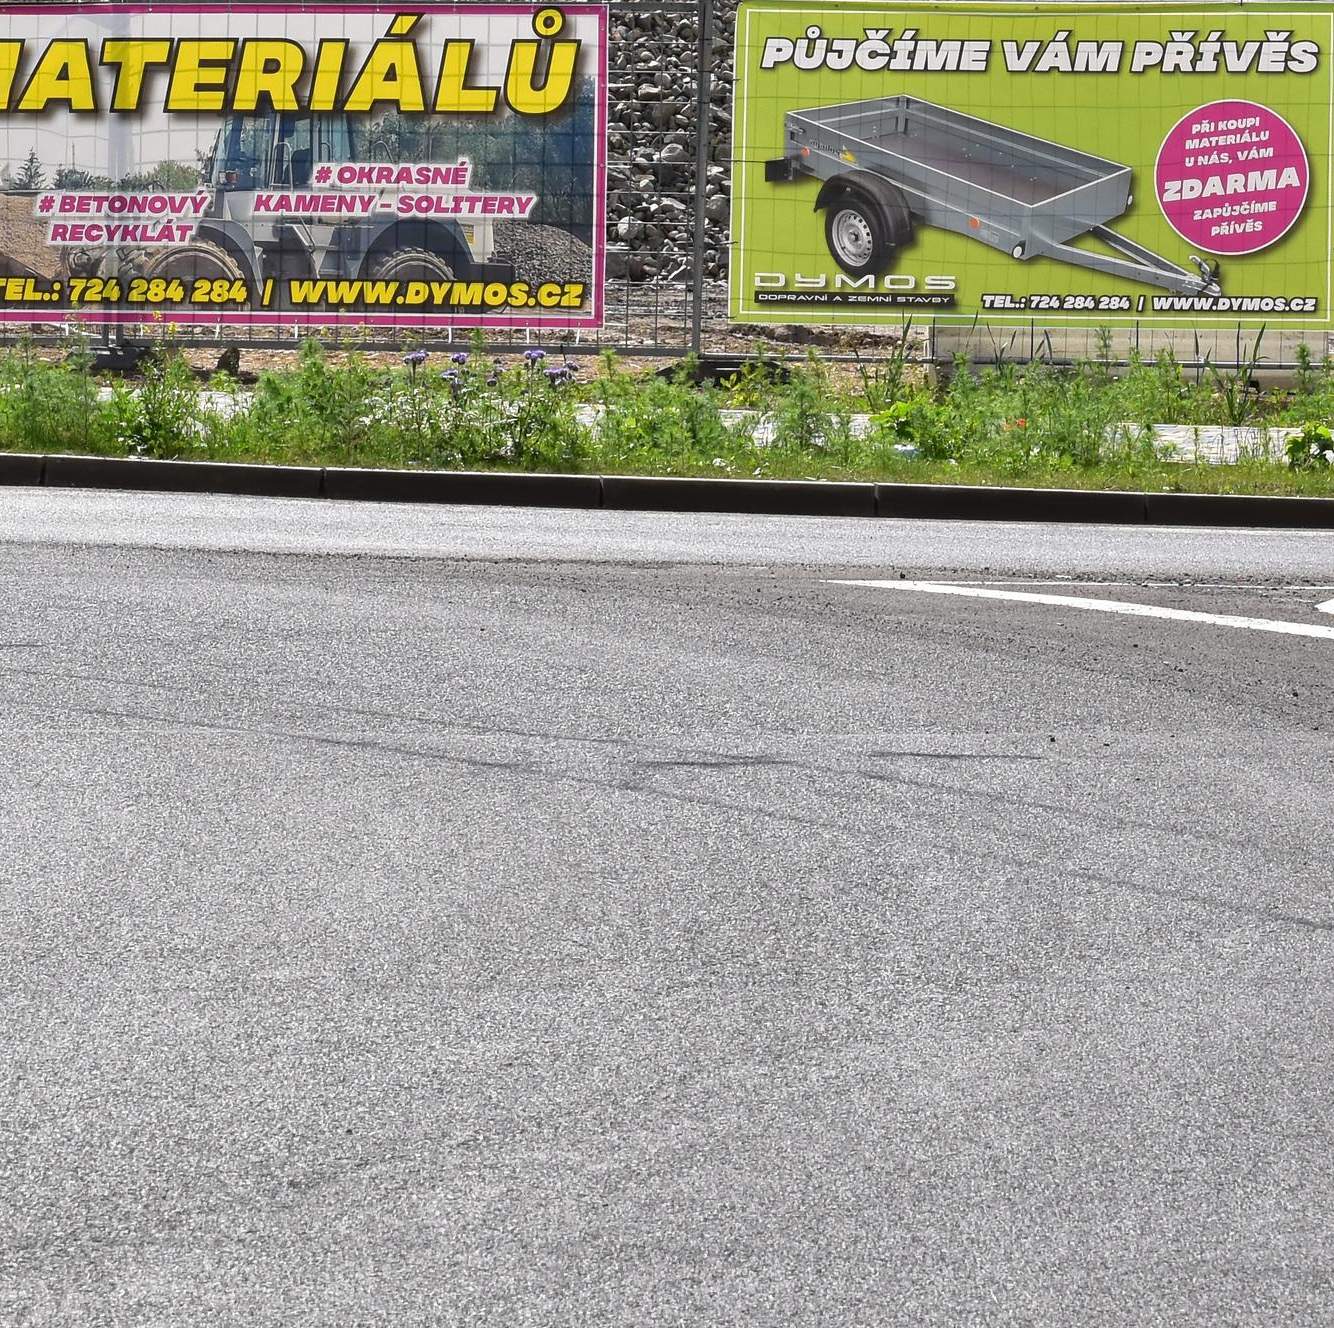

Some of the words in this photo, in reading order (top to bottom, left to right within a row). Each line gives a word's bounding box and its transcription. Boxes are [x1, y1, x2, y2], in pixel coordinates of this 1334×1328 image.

[760, 25, 992, 72] PŮJČÍME
[1001, 30, 1124, 73] VÁM
[1129, 30, 1320, 73] PŘÍVĚS
[1191, 119, 1215, 135] PŘI
[1217, 116, 1260, 132] KOUPI
[1185, 130, 1270, 150] MATERIÁLU
[1184, 157, 1194, 167] U
[1198, 151, 1232, 166] NÁS,
[1237, 146, 1274, 161] VÁM
[1162, 166, 1301, 202] ZDARMA
[253, 194, 376, 213] KAMENY
[397, 195, 534, 214] SOLITERY
[1193, 200, 1277, 221] ZAPŮJČÍME
[50, 218, 194, 243] RECYKLÁT
[1211, 219, 1263, 237] PŘÍVĚS
[754, 272, 956, 290] DYMOS
[69, 278, 120, 302] 724
[128, 278, 184, 303] 284
[191, 279, 247, 303] 284
[289, 280, 585, 308] WWW.DYMOS.CZ
[758, 293, 828, 302] DOPRAVNÍ
[848, 294, 892, 303] ZEMNÍ
[896, 296, 951, 304] STAVBY
[981, 294, 1027, 309] TEL.:
[1029, 294, 1061, 310] 724
[1063, 295, 1096, 310] 284
[1098, 295, 1131, 310] 284
[1152, 295, 1318, 312] WWW.DYMOS.CZ
